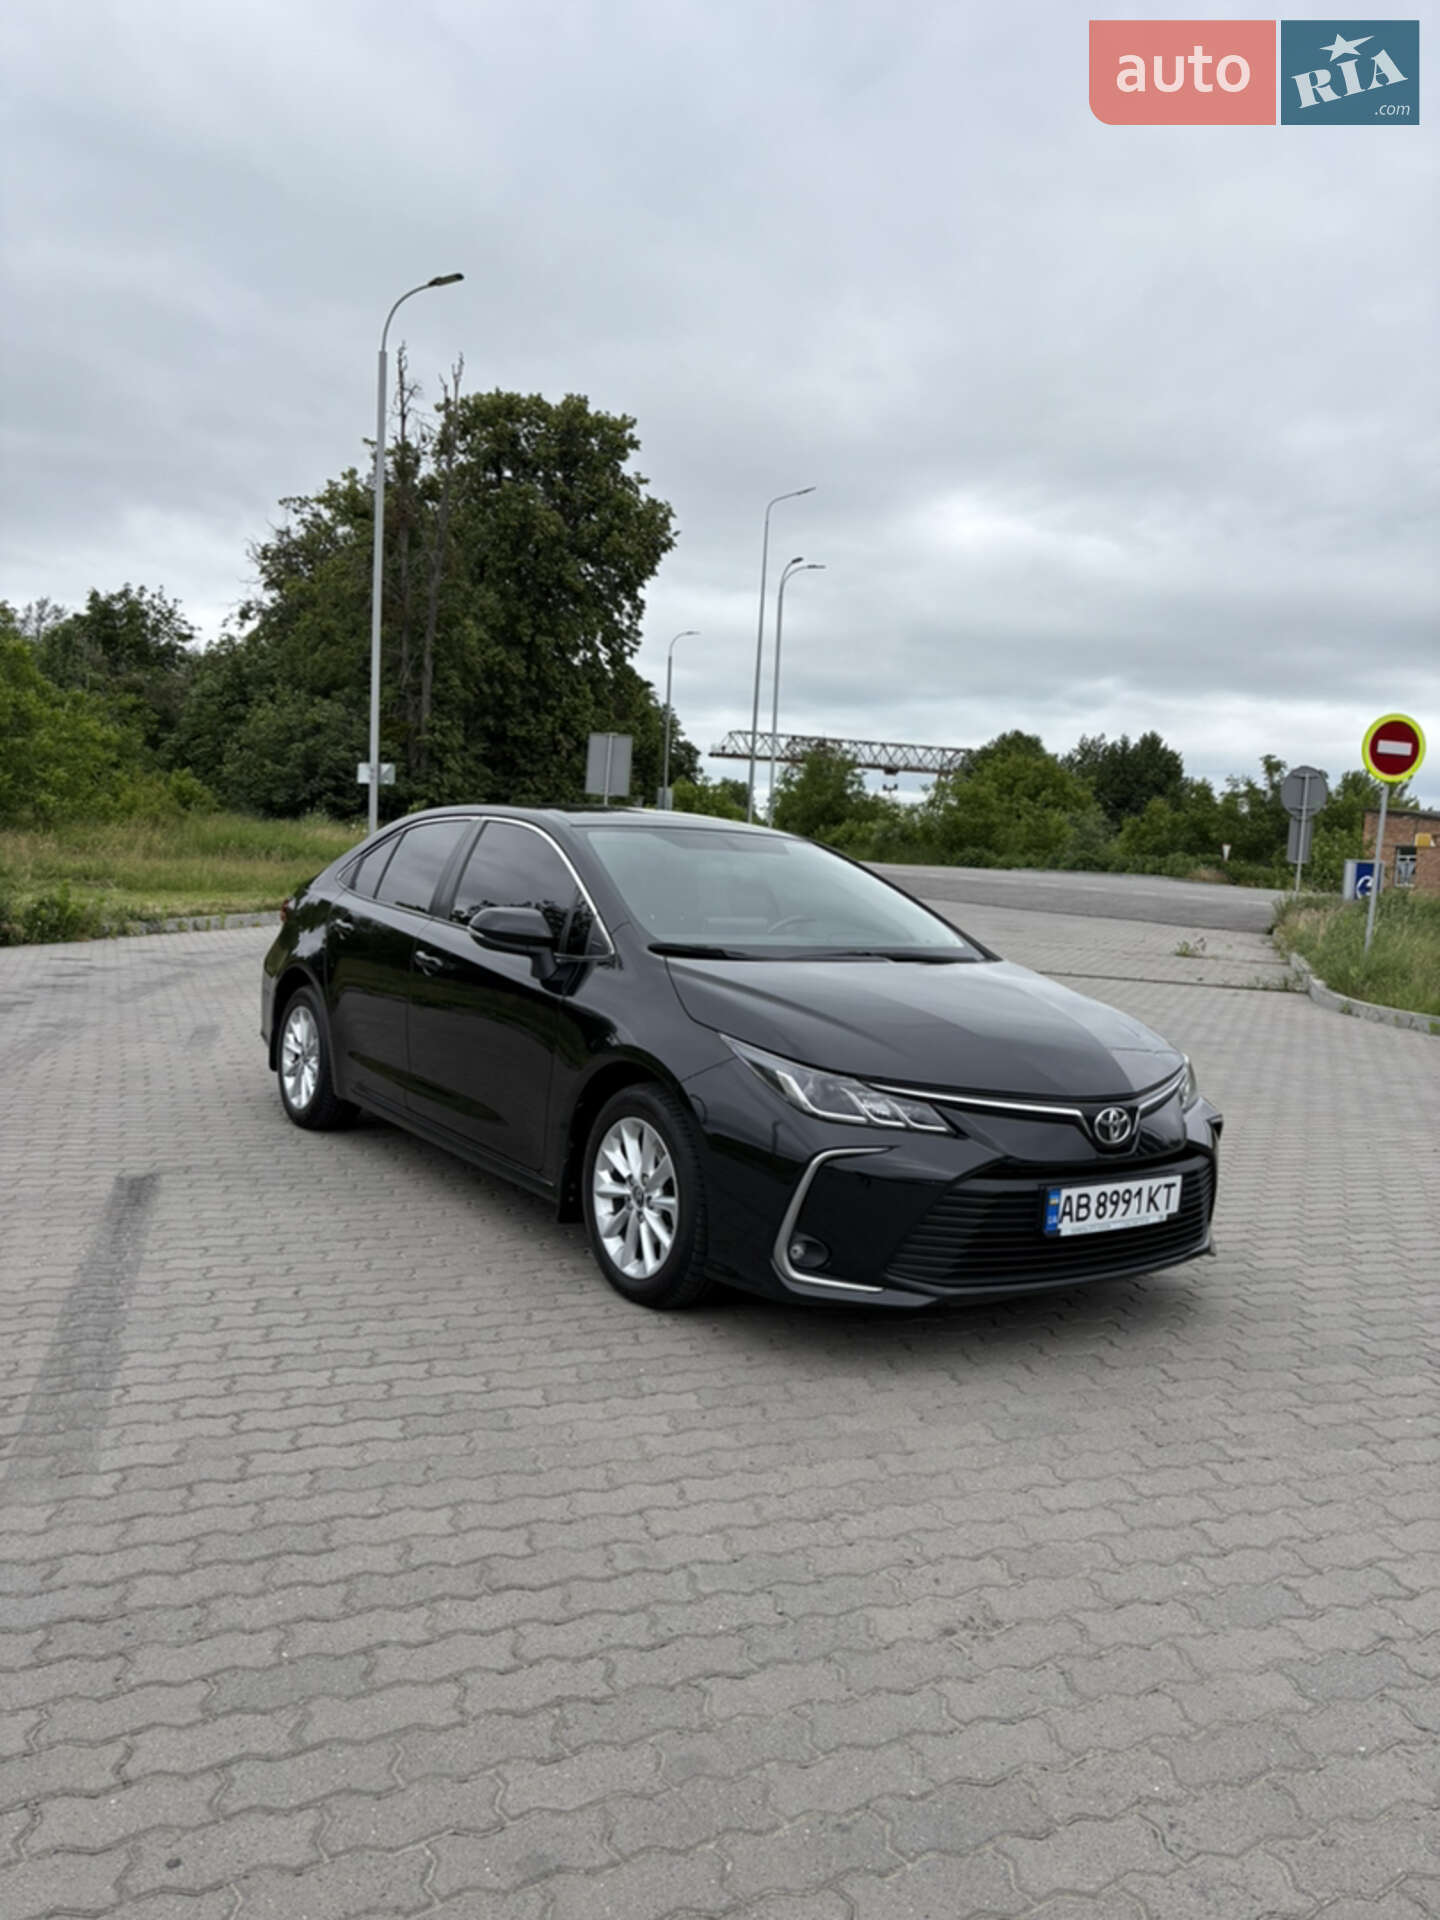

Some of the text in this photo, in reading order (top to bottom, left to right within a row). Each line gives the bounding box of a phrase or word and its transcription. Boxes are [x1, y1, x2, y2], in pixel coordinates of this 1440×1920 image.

[1060, 1183, 1176, 1223] AB 8991 KT
